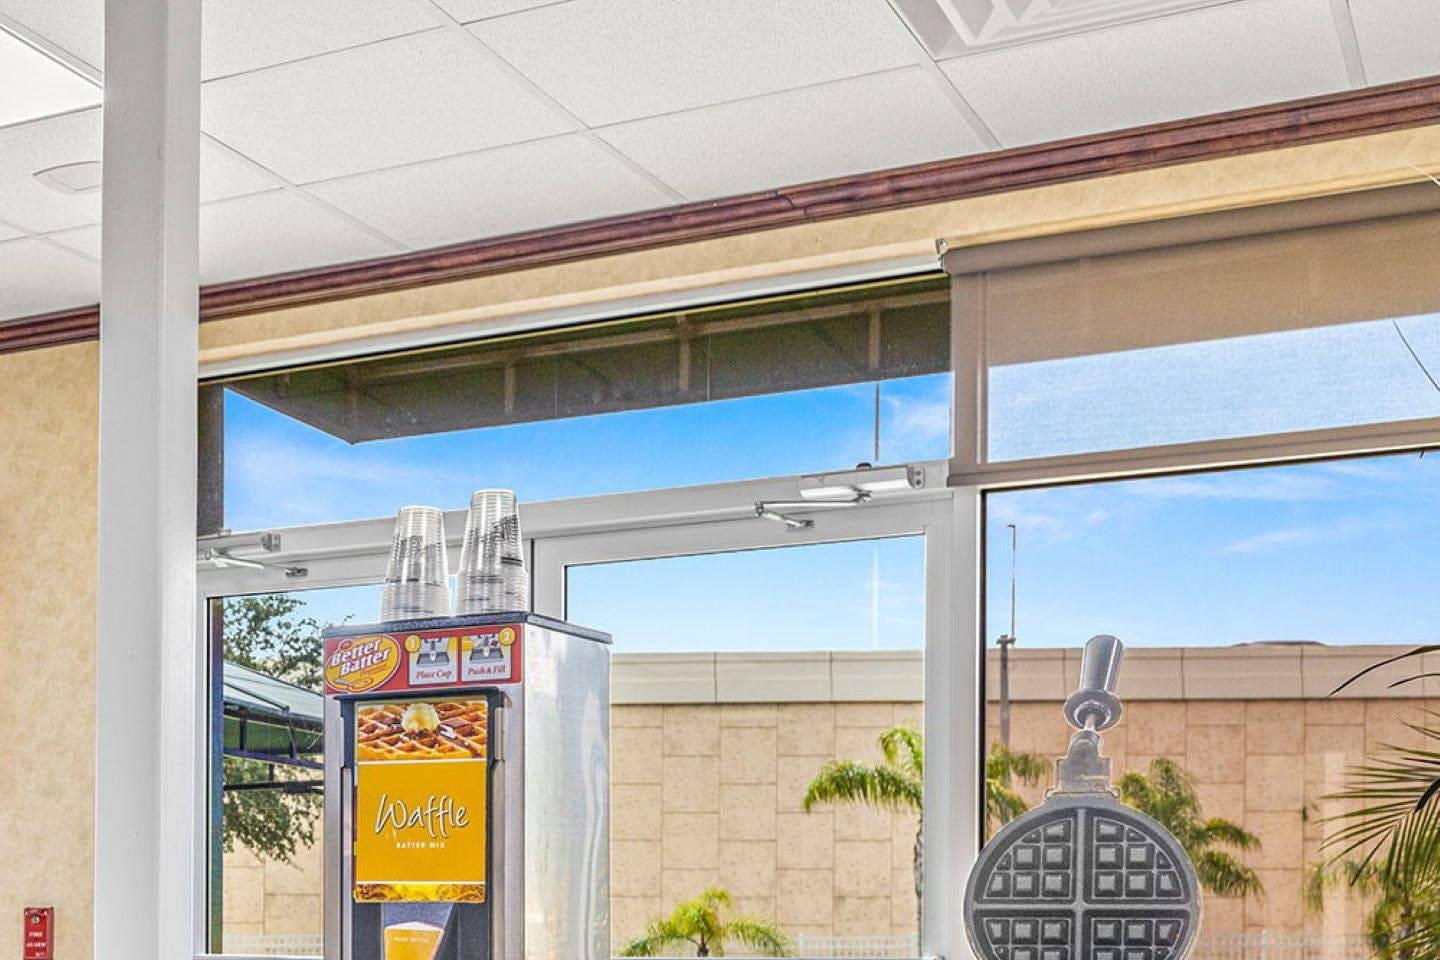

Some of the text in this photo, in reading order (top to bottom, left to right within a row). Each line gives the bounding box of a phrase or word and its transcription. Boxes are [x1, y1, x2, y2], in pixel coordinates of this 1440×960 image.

[331, 638, 382, 667] Better
[340, 648, 392, 676] Batter
[374, 794, 469, 838] Waffle
